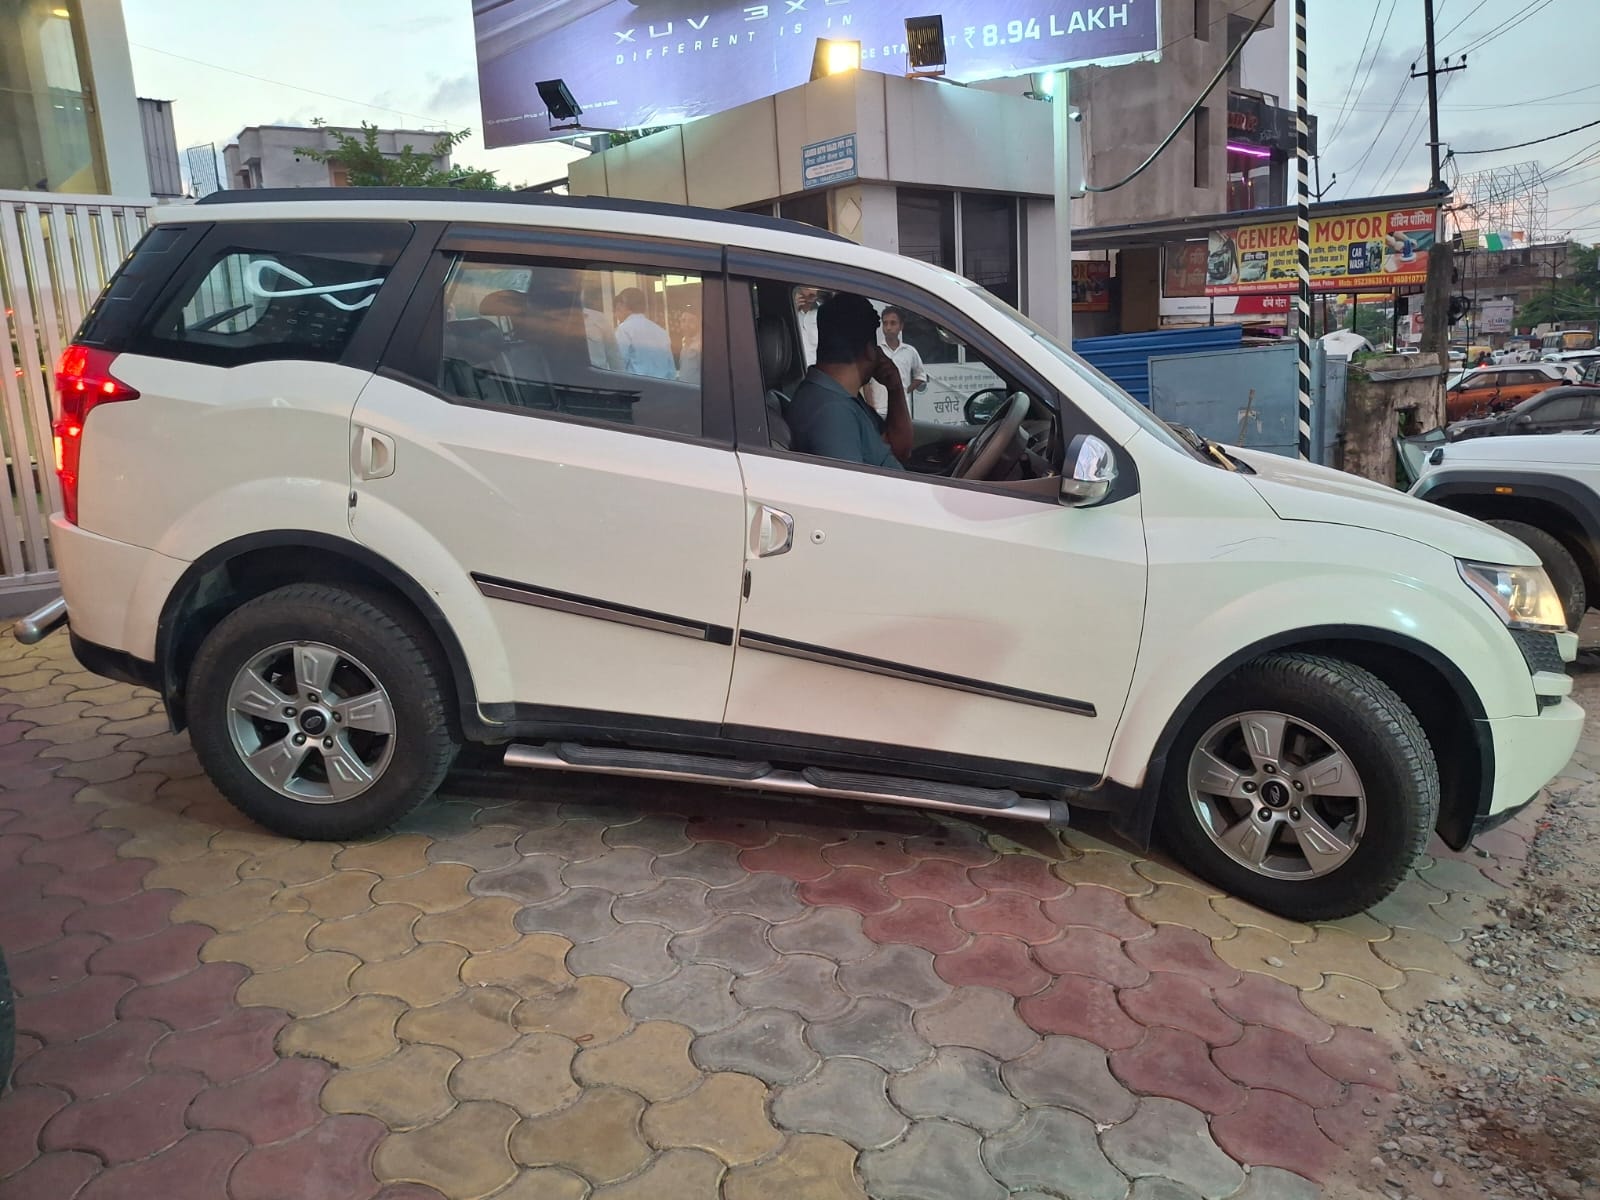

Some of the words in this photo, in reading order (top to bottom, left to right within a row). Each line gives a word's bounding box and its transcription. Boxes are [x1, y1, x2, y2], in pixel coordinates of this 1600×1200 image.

[613, 15, 710, 45] XUV
[616, 31, 755, 65] DIFFERENT
[780, 23, 802, 36] IS
[827, 14, 852, 29] IN
[982, 17, 1041, 47] 8.94
[1238, 224, 1298, 250] GENERA
[1315, 217, 1382, 242] MOTOR
[1351, 247, 1363, 258] CAR
